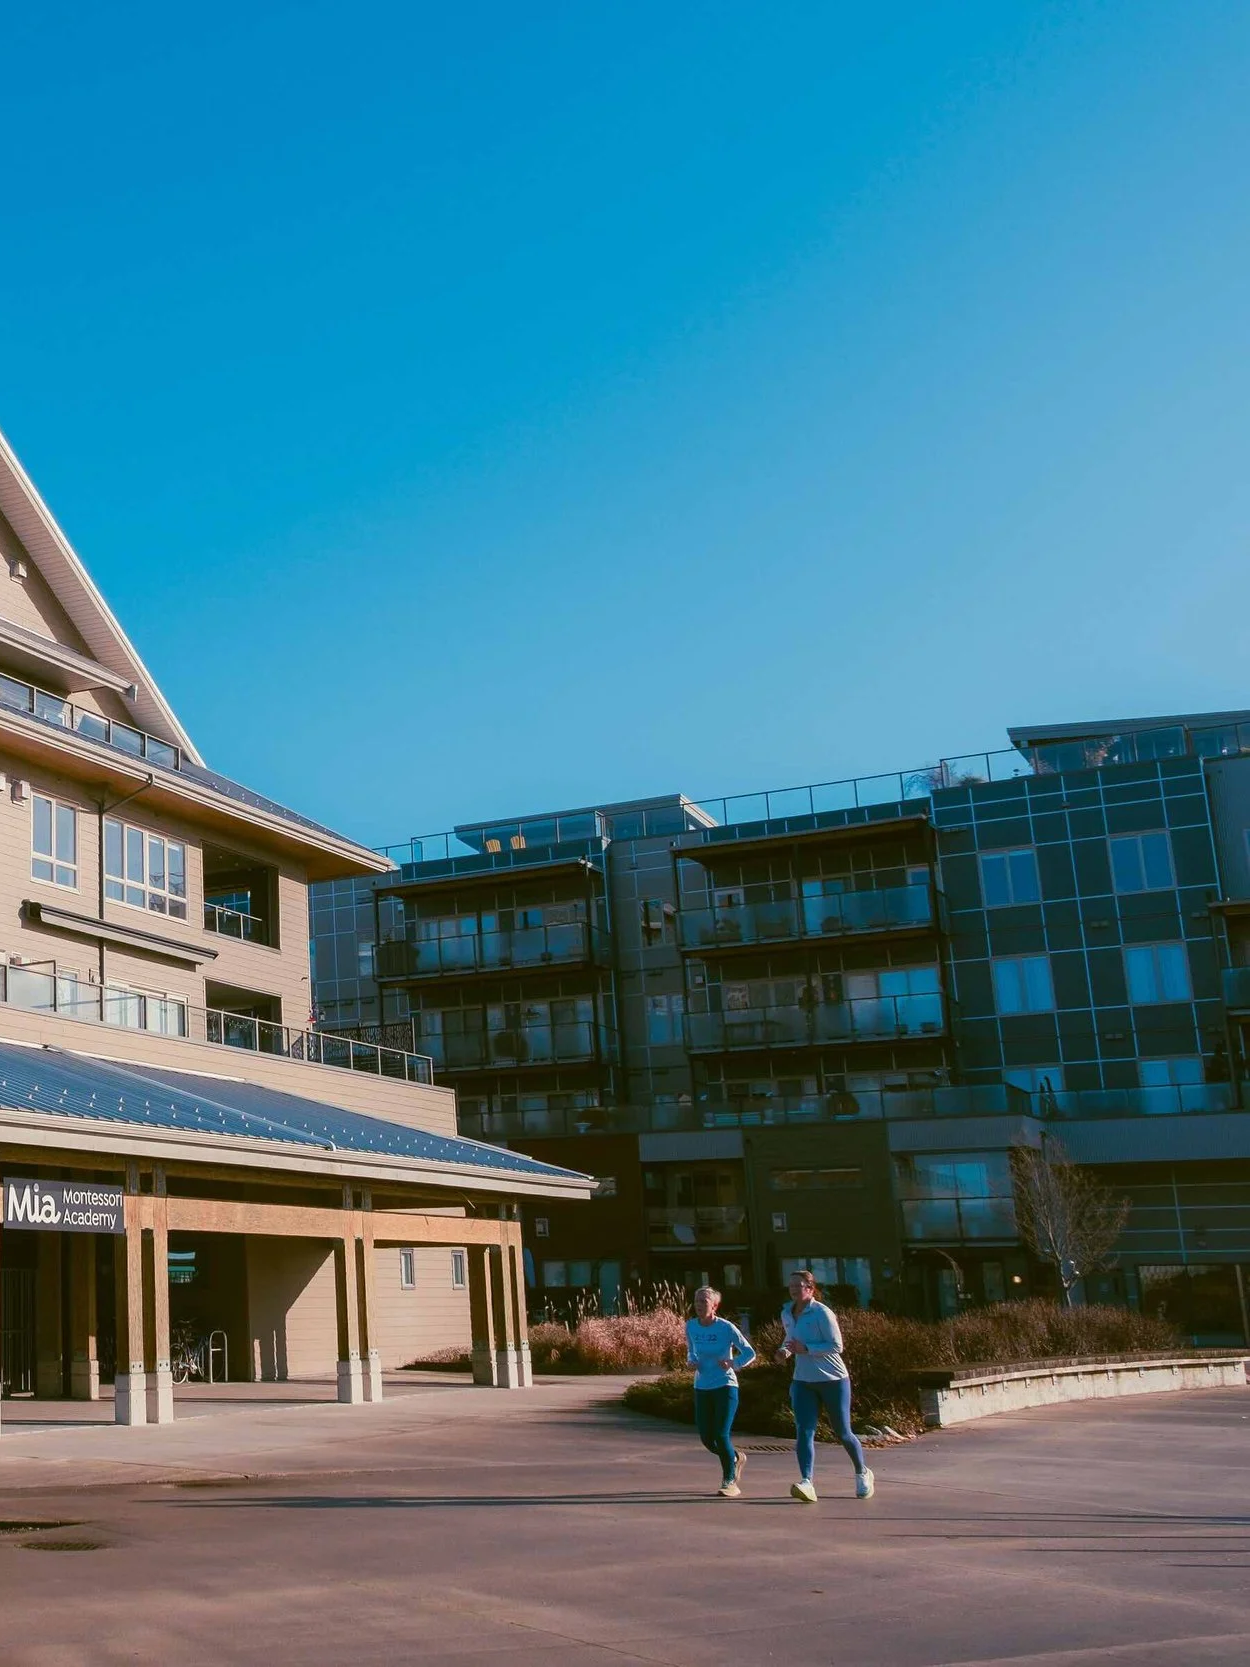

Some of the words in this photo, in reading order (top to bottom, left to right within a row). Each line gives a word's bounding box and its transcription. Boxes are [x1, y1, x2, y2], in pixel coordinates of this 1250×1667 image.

[8, 1183, 61, 1224] Mia
[63, 1188, 123, 1207] Montessori
[63, 1209, 117, 1230] Academy
